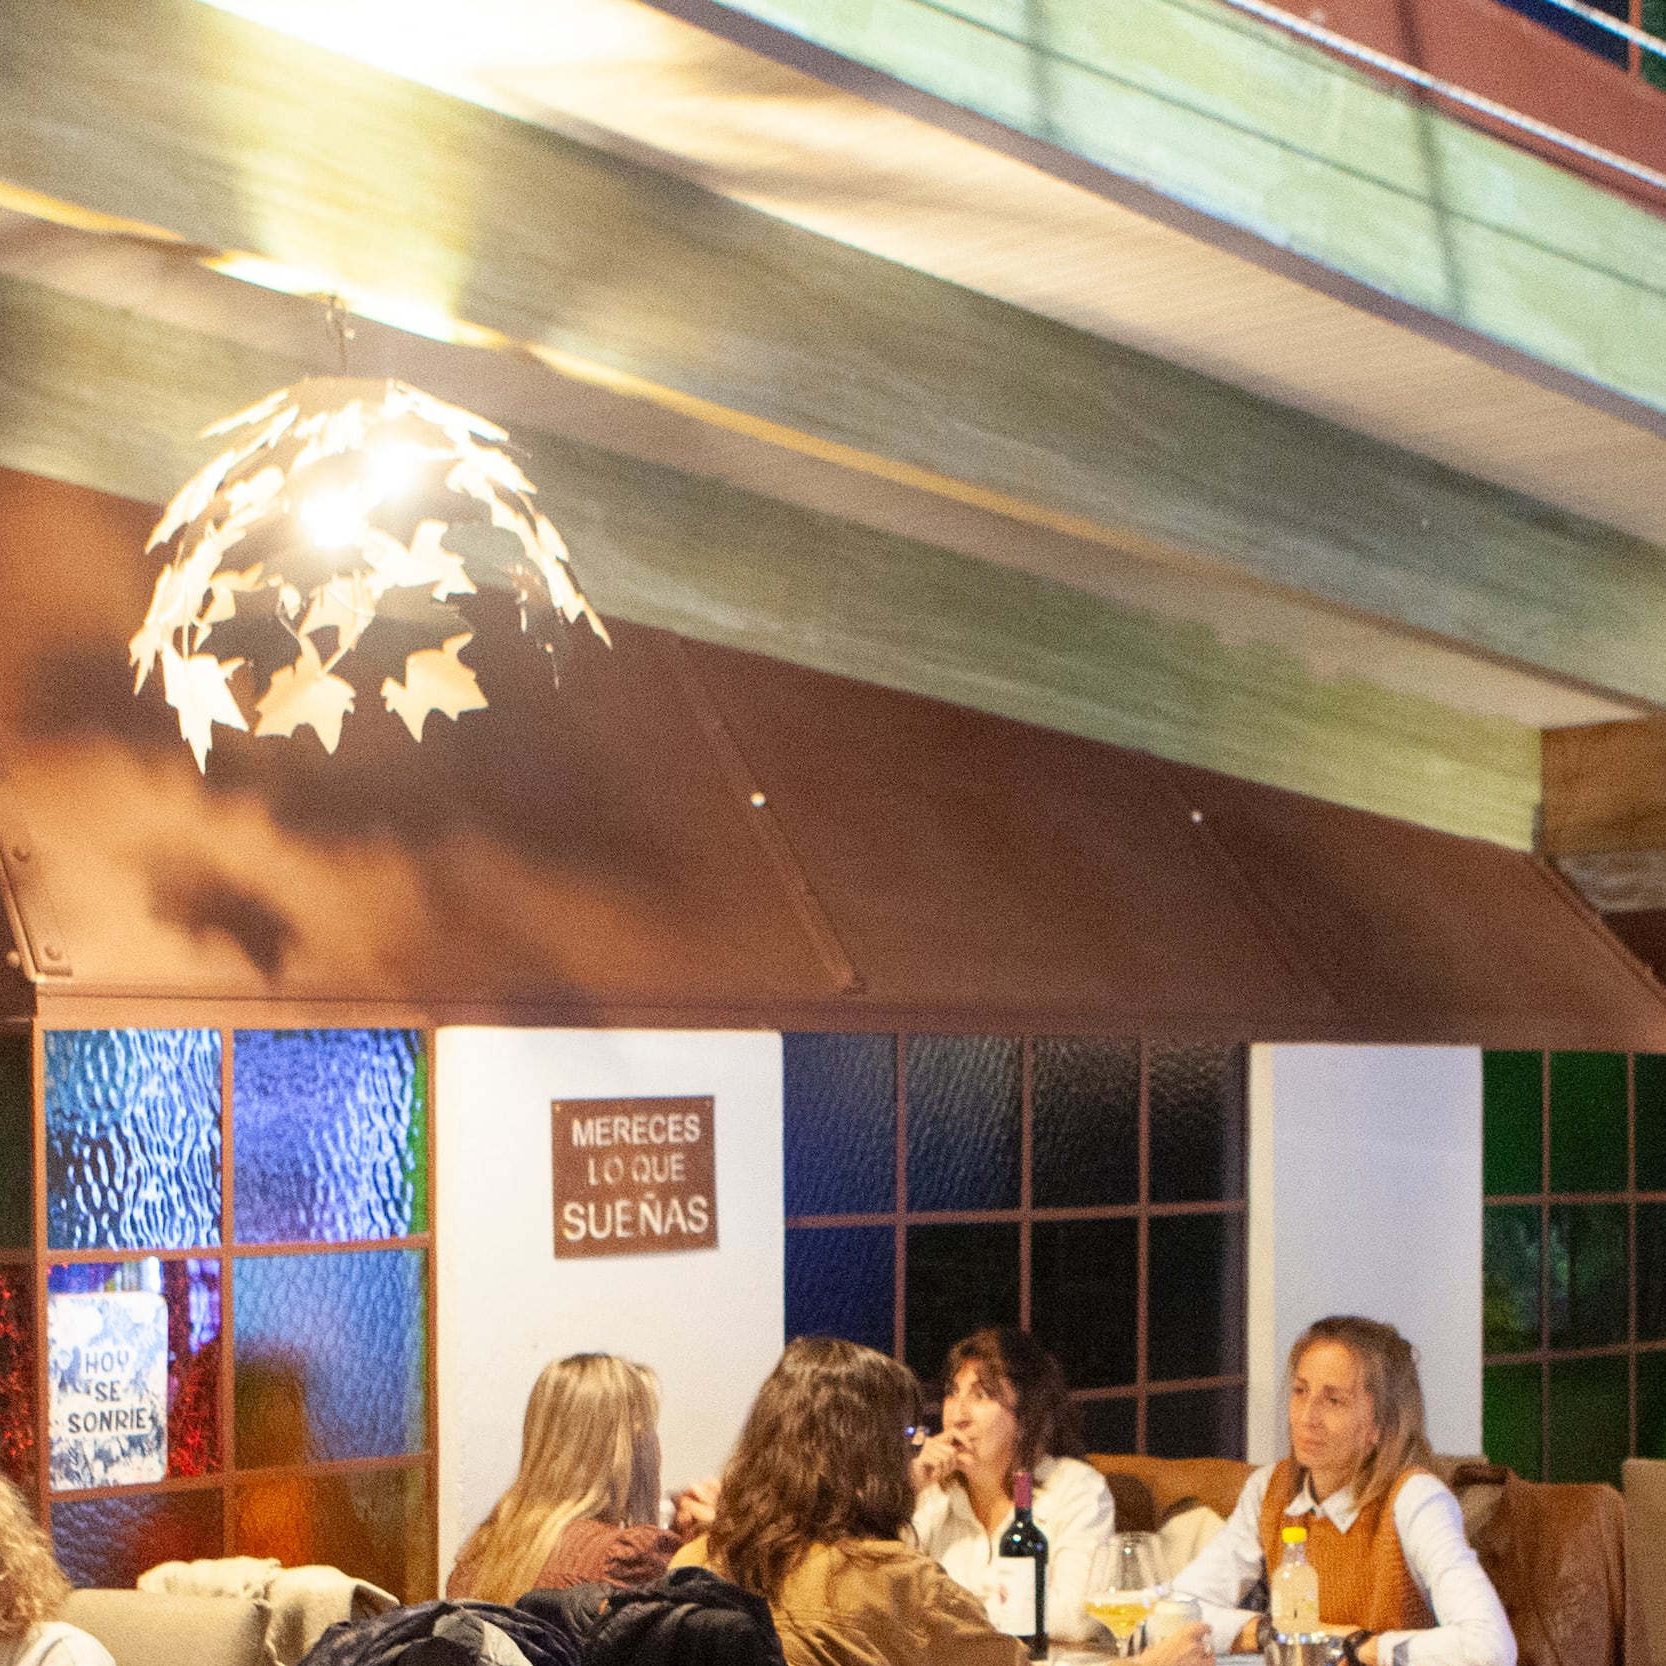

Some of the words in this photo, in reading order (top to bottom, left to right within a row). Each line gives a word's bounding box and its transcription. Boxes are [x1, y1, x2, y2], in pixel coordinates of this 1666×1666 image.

[572, 1113, 701, 1148] MERECES
[588, 1156, 624, 1186] LO
[632, 1152, 686, 1184] QUE
[563, 1191, 709, 1241] SUEÑAS
[85, 1351, 129, 1374] HOY
[95, 1380, 121, 1402] SE
[68, 1408, 148, 1435] SONRIE
